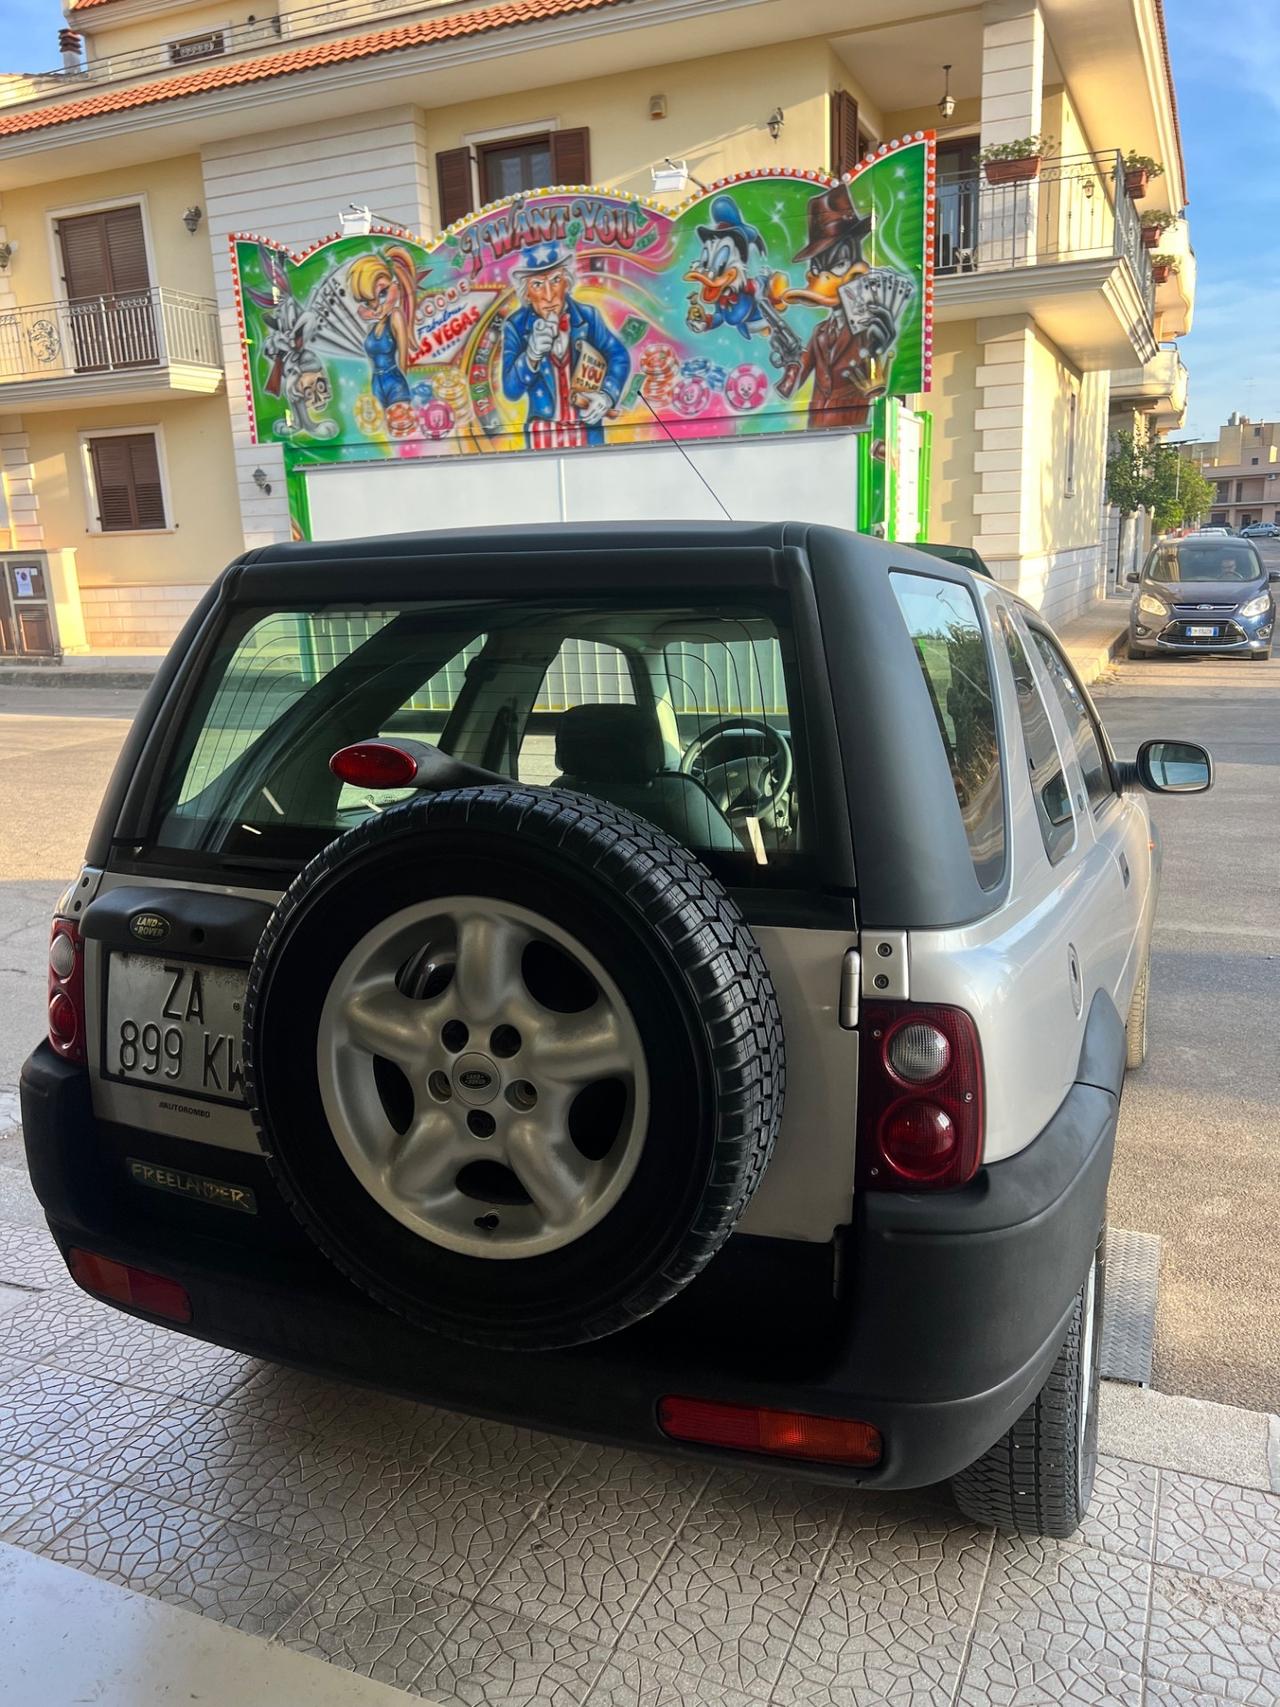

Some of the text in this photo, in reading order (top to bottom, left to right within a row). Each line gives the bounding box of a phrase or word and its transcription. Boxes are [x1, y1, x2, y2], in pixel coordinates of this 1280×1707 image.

[461, 198, 638, 280] I WANT YOU
[408, 305, 481, 364] LAS VEGAS
[582, 363, 603, 384] YOU
[163, 965, 204, 1025] ZA
[119, 1019, 183, 1080] 899
